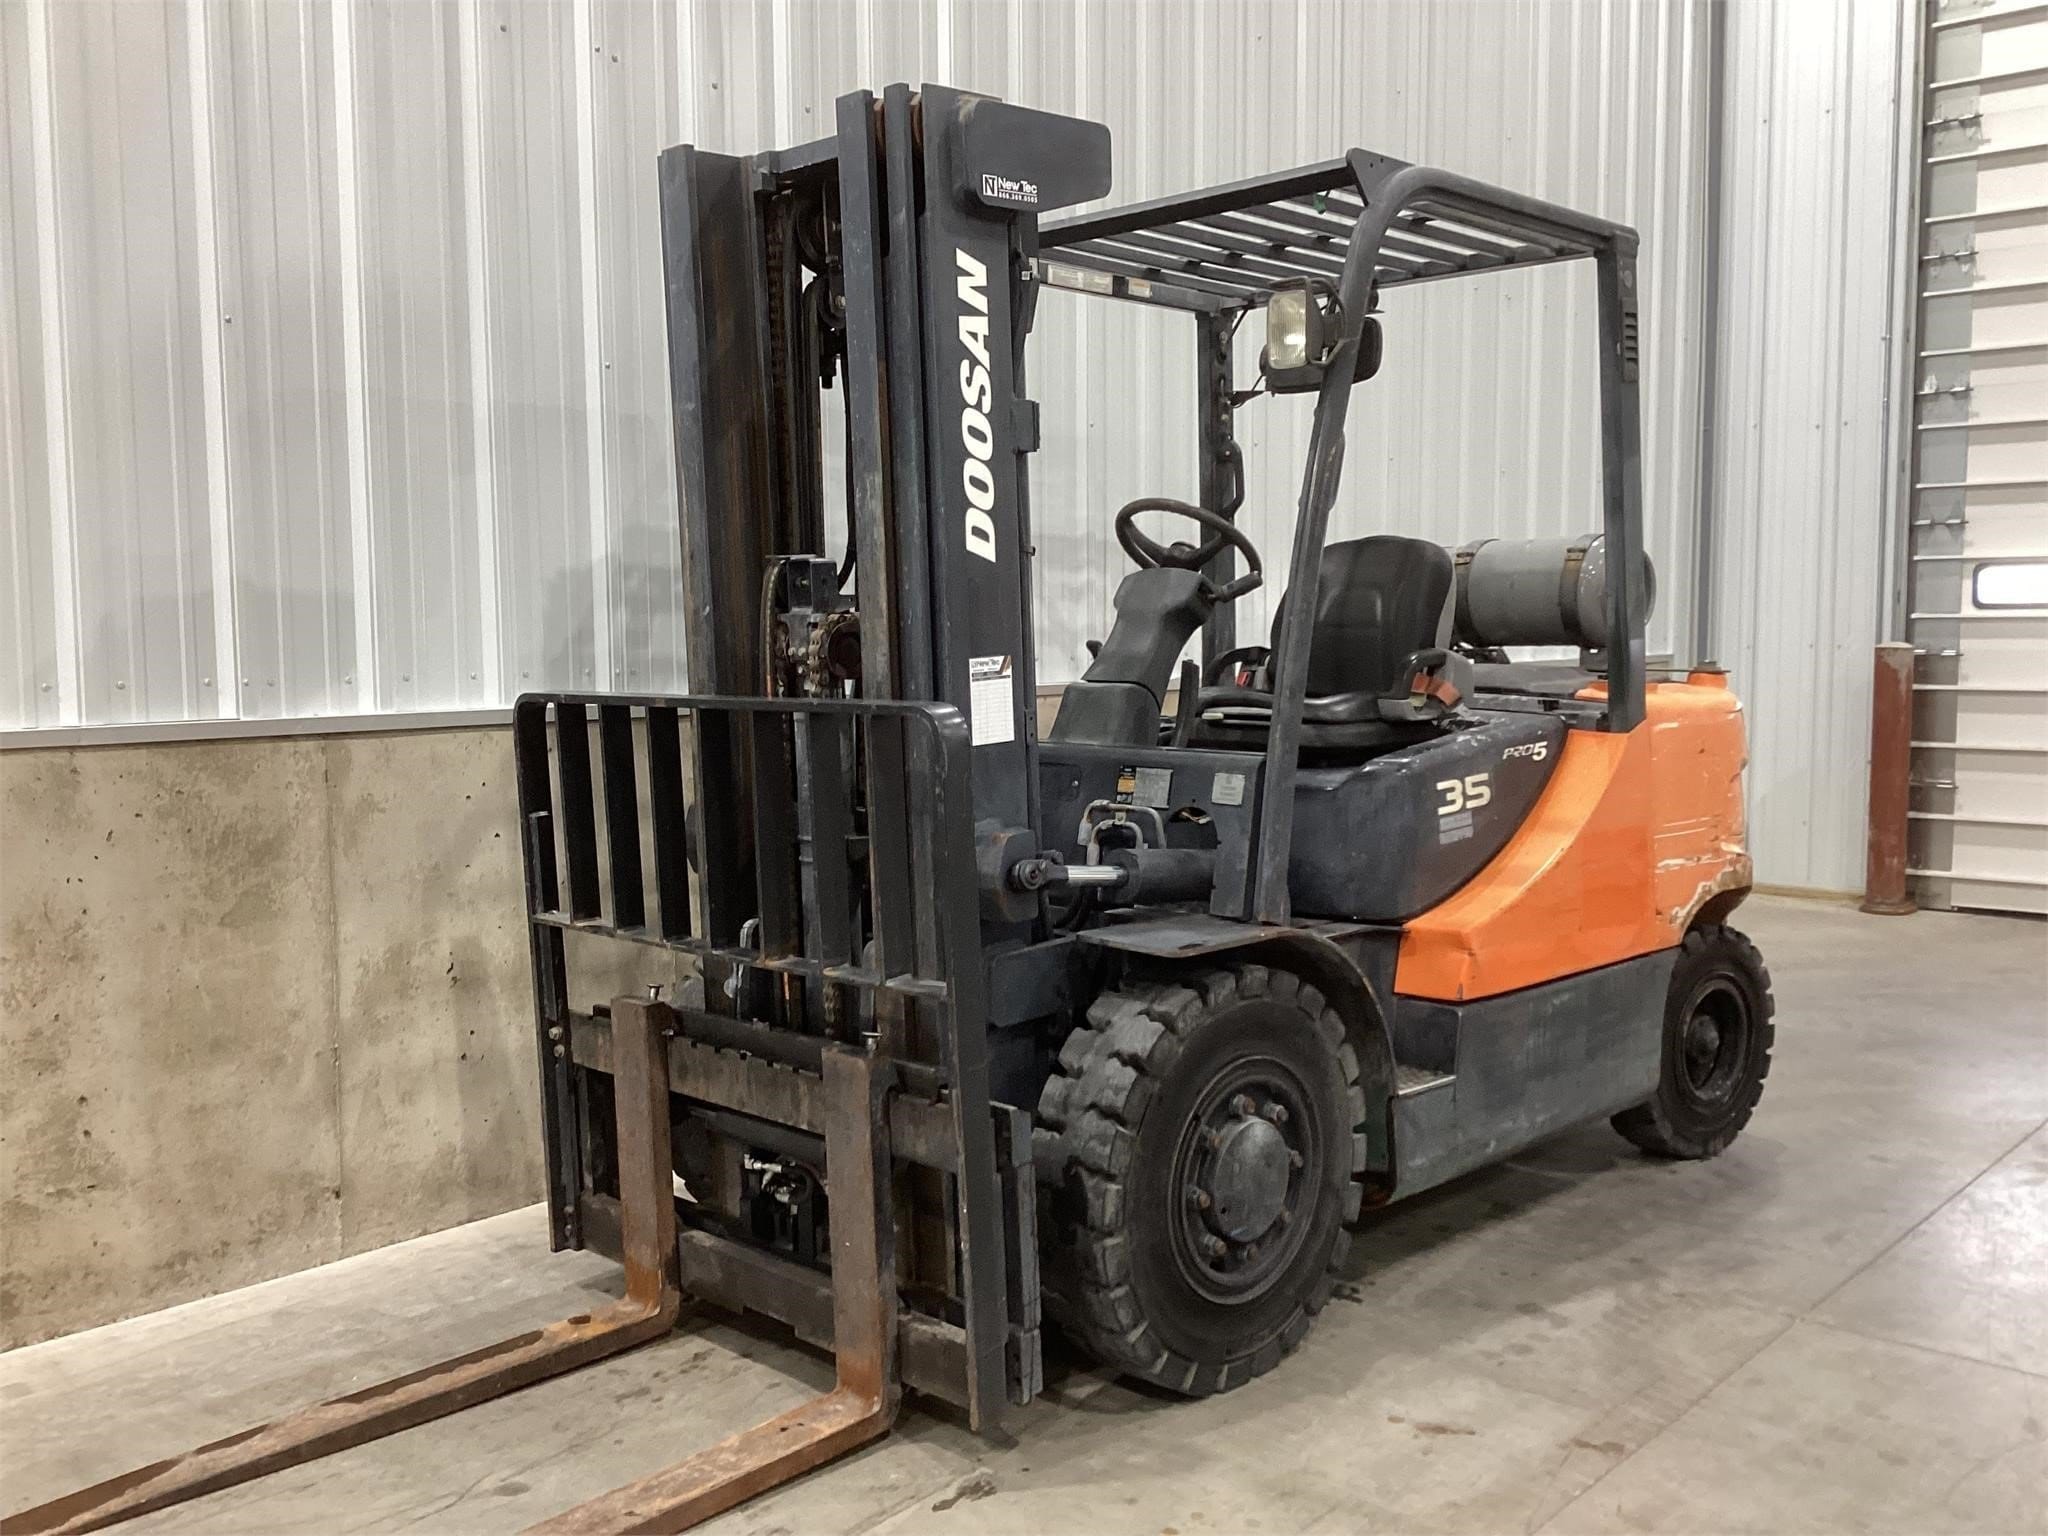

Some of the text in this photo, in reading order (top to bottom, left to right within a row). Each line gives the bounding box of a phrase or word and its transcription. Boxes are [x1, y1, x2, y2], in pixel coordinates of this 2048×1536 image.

[998, 176, 1020, 191] New
[1020, 180, 1038, 194] Tec
[956, 247, 996, 563] DOOSAN
[1436, 772, 1491, 815] 35
